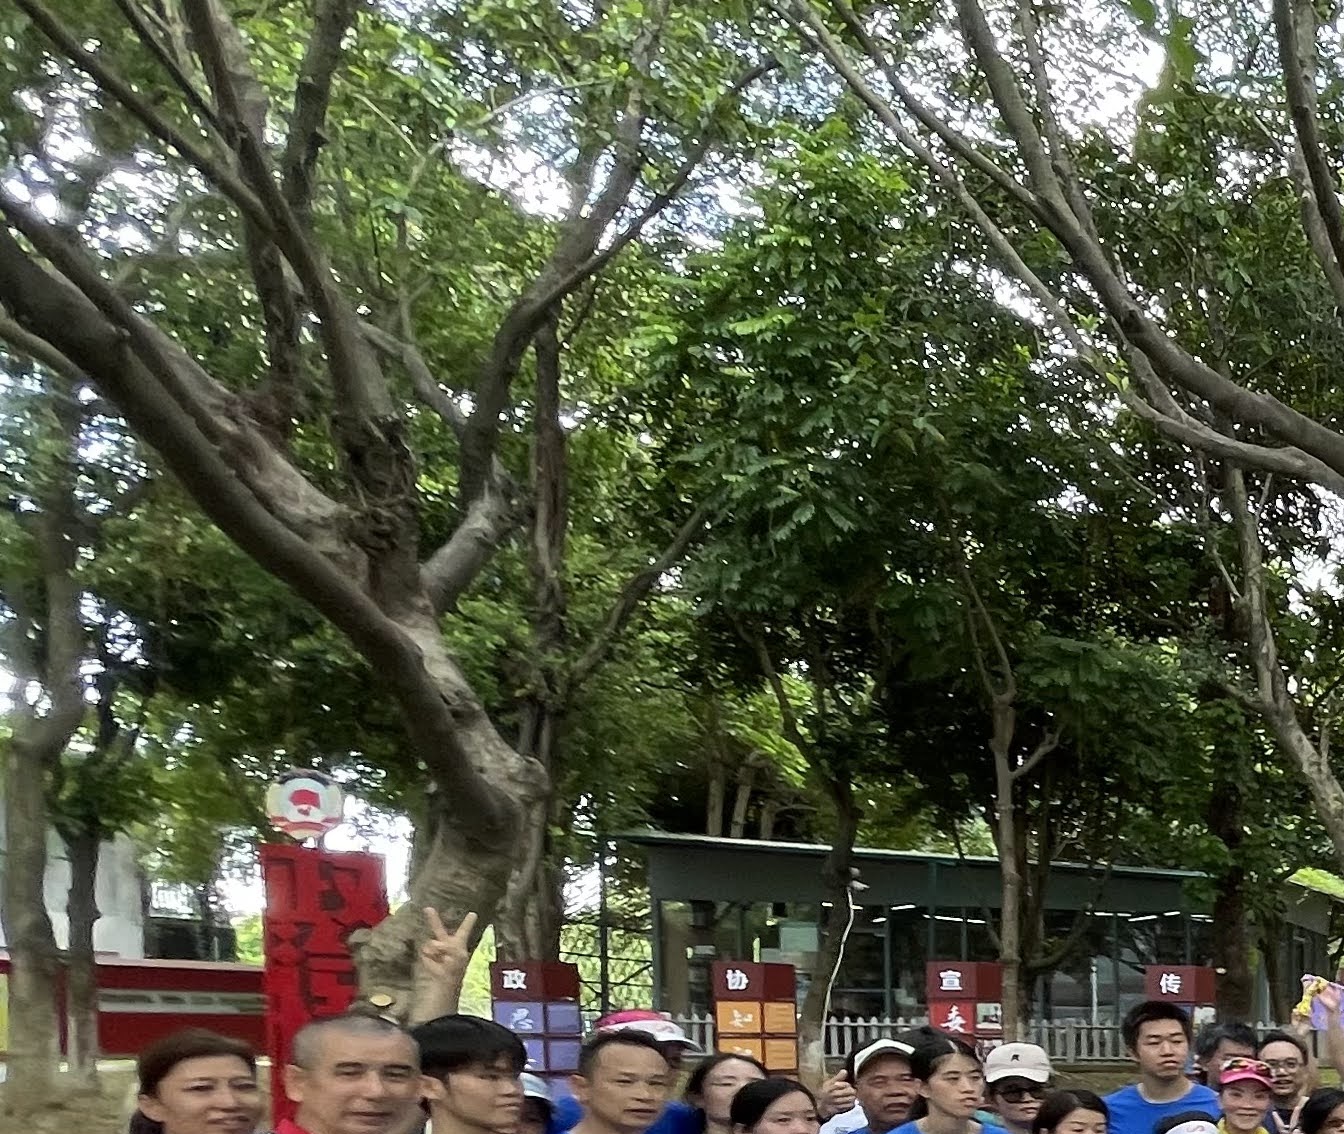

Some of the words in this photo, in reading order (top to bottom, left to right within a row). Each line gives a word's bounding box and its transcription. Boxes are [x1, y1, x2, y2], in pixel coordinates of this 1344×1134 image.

[502, 968, 527, 991] 政
[726, 968, 749, 991] 协
[939, 969, 963, 991] 宣
[1159, 973, 1182, 995] 传
